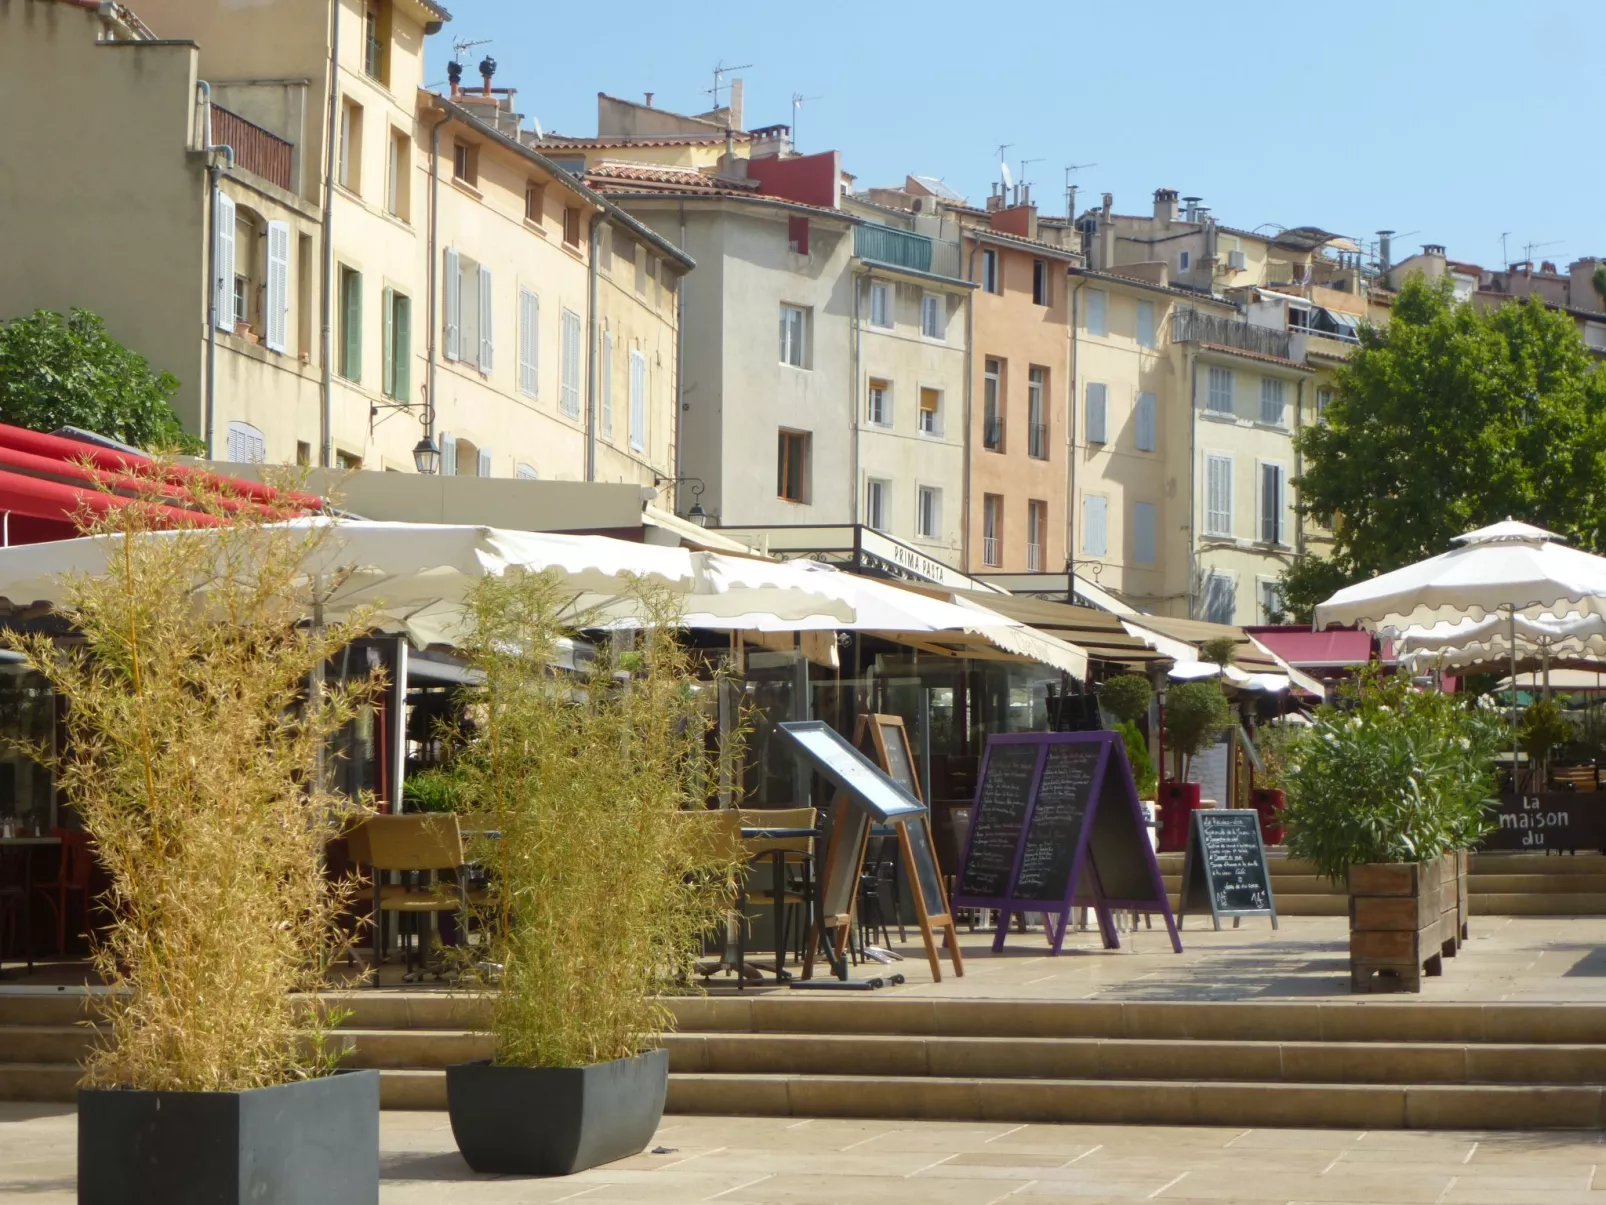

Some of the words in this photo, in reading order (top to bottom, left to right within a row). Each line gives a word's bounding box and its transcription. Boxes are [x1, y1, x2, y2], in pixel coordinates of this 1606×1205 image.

[894, 546, 920, 571] PRIMA
[922, 560, 944, 583] PASTA
[1523, 795, 1540, 810] La
[1498, 811, 1569, 829] maison
[1521, 830, 1544, 845] du
